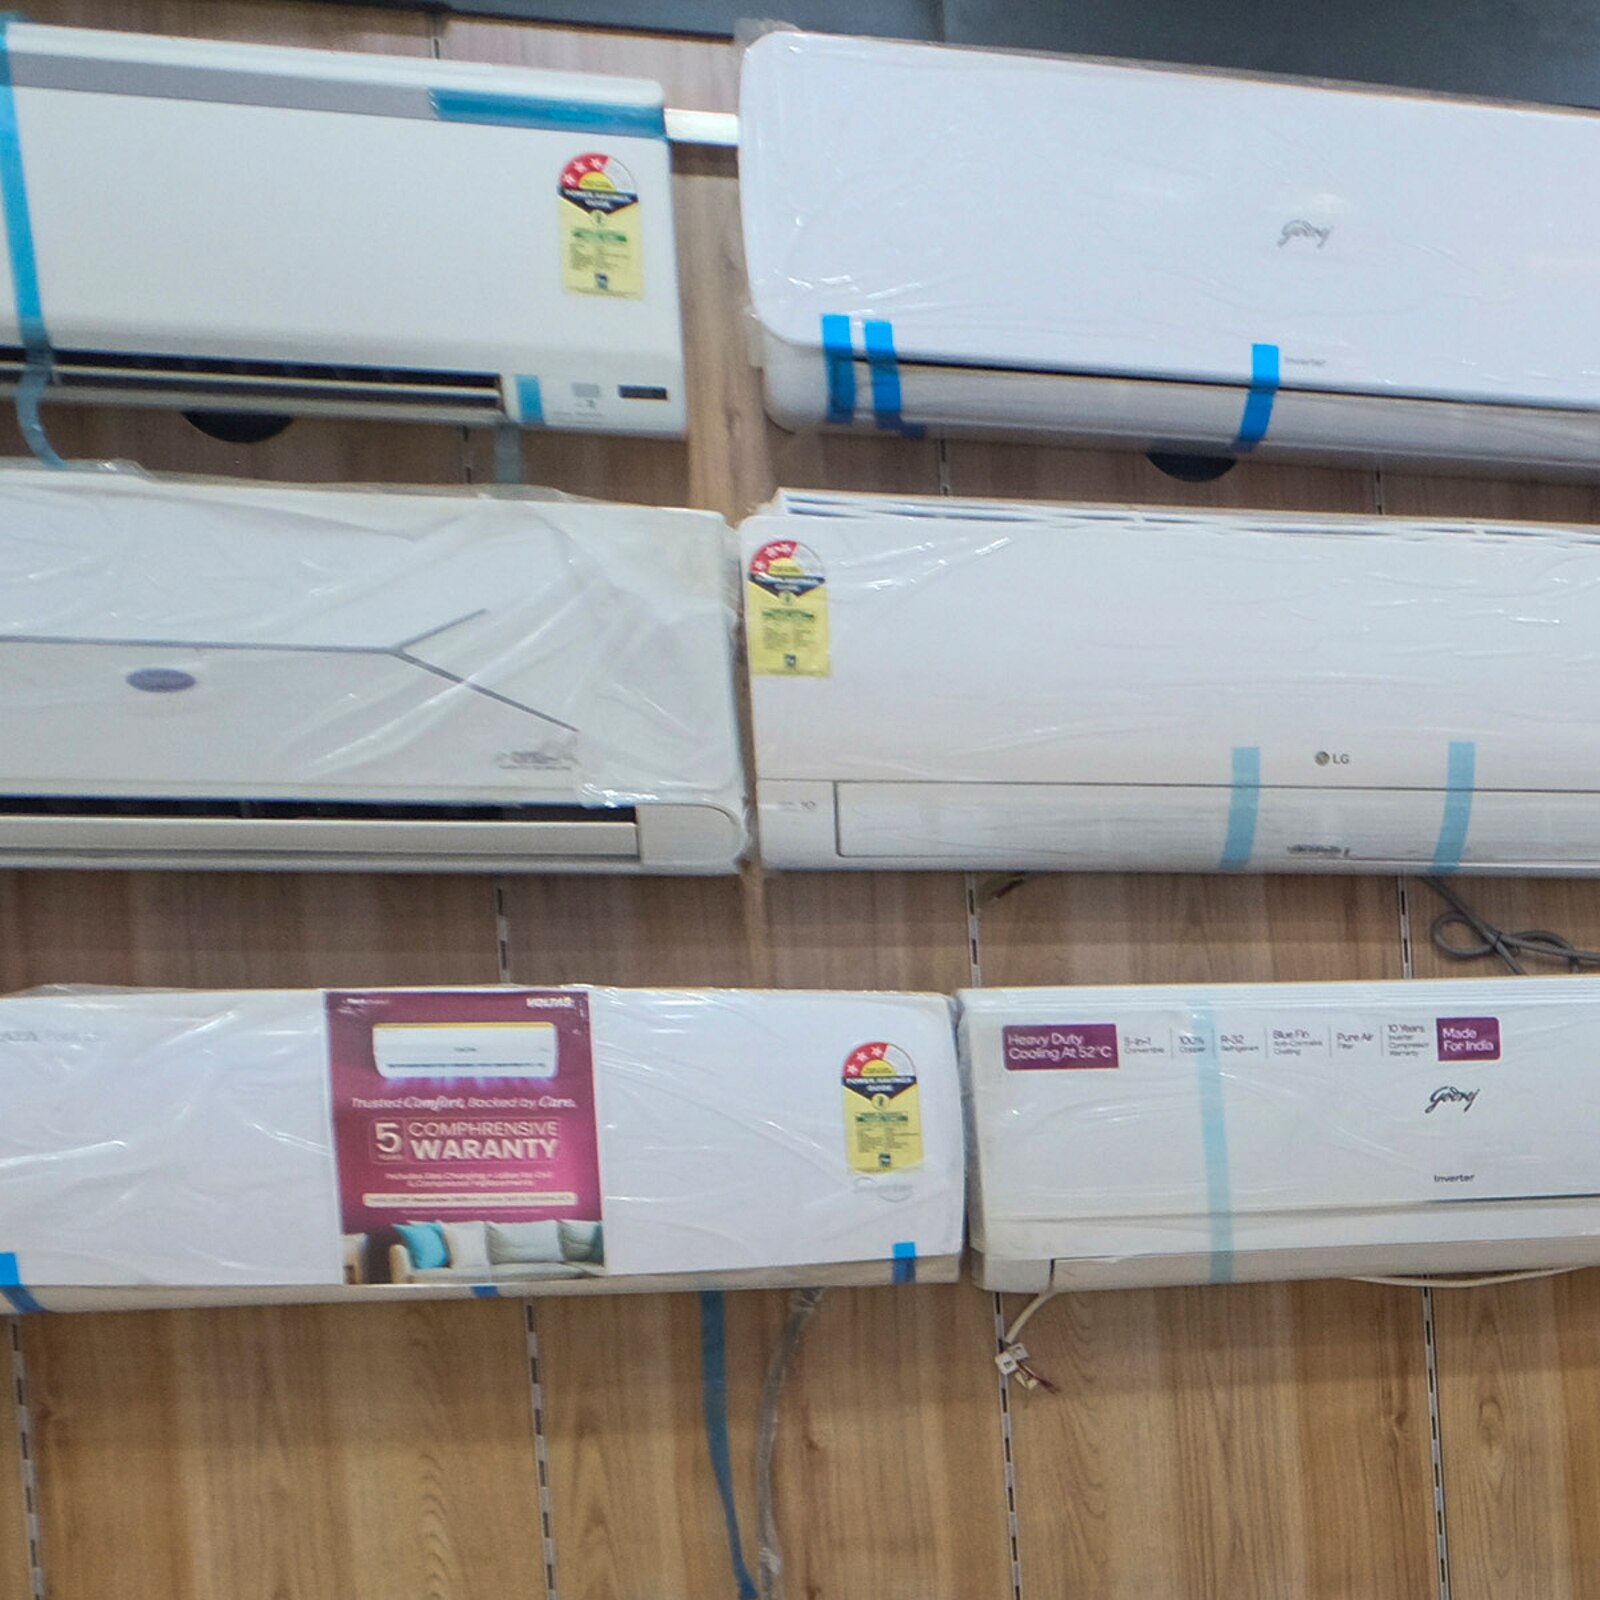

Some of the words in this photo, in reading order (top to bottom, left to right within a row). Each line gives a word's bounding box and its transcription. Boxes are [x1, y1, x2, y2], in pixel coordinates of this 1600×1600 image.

[1332, 753, 1350, 765] LG
[1272, 1029, 1295, 1041] Blue
[1398, 1023, 1425, 1034] Years
[1441, 1027, 1478, 1040] Made
[1007, 1033, 1049, 1047] Heavy
[1050, 1033, 1084, 1048] Duty
[1336, 1032, 1360, 1043] Pure
[1359, 1031, 1374, 1042] Air
[1443, 1040, 1464, 1052] For
[1465, 1038, 1495, 1051] India
[1008, 1046, 1060, 1063] Cooling
[1061, 1047, 1078, 1059] At
[351, 1097, 401, 1109] Trusted
[468, 1096, 517, 1108] Backed
[374, 1122, 402, 1154] 5
[410, 1138, 560, 1161] WARANTY
[1433, 1173, 1475, 1184] Inverter
